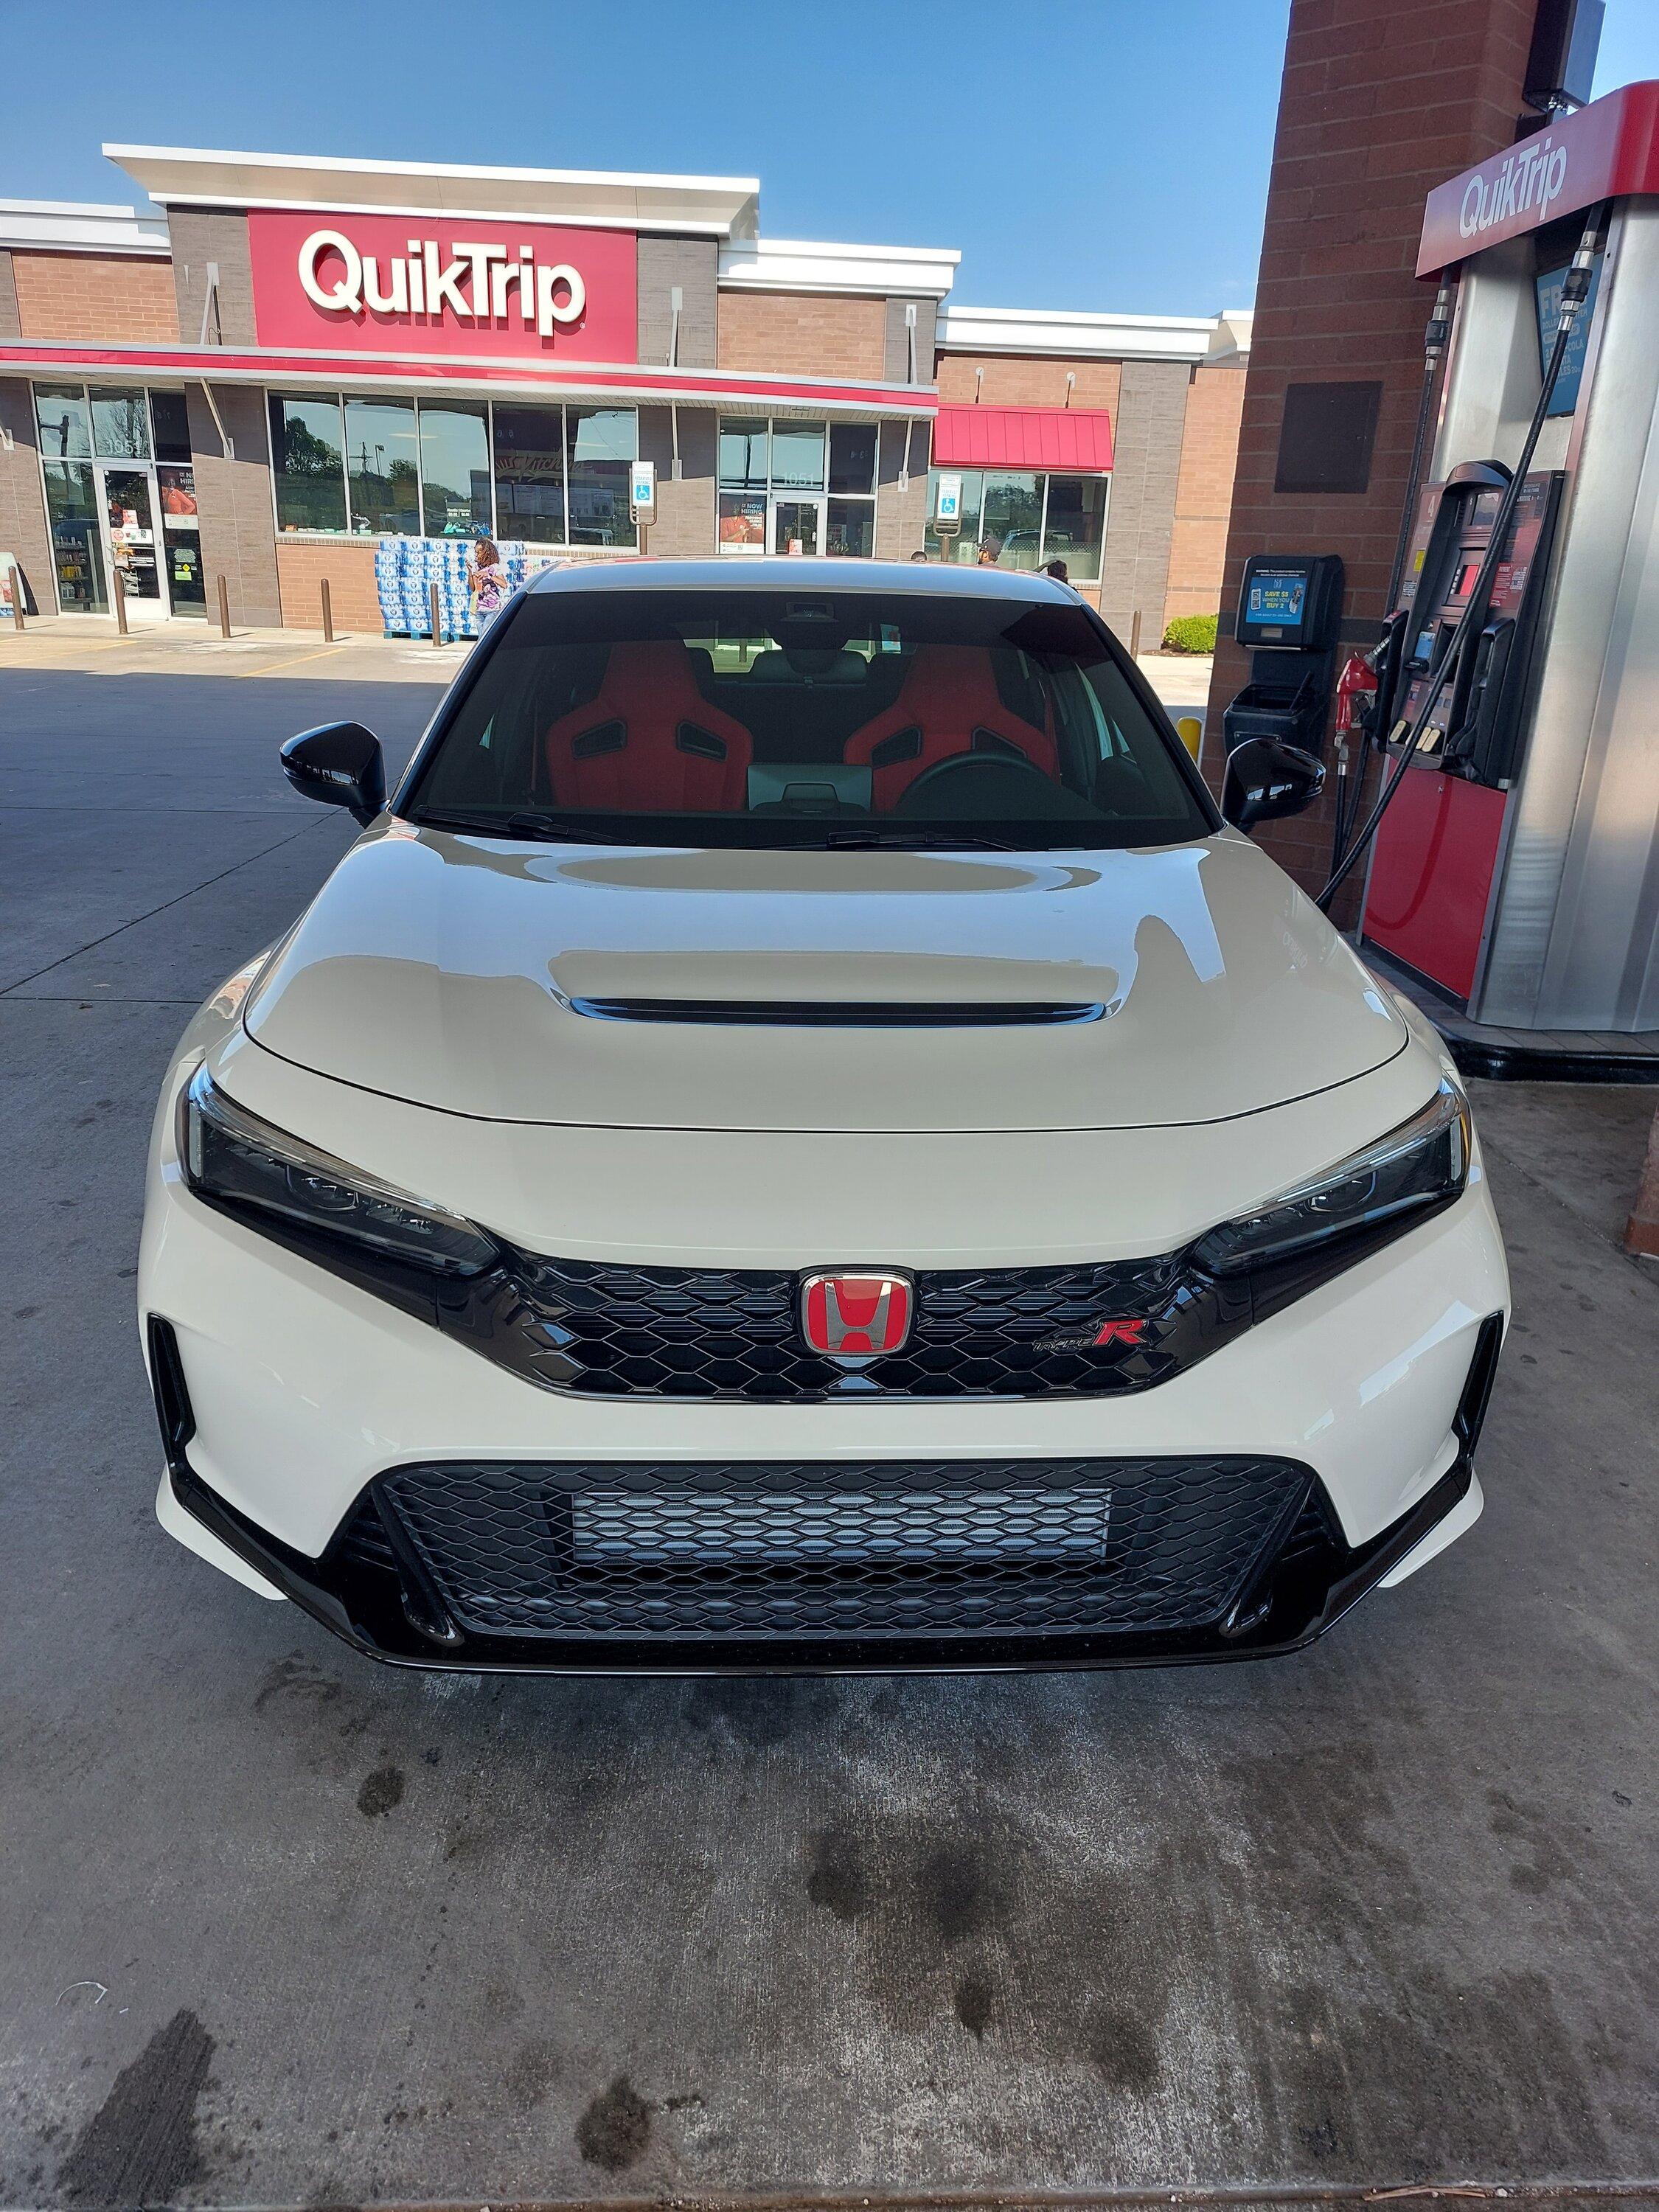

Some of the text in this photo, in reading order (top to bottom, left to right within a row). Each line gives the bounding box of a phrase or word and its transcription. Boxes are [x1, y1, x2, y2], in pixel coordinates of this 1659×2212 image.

[1459, 136, 1567, 239] QuikTrip
[298, 229, 587, 338] QuikTrip
[784, 472, 814, 487] 1051
[1427, 495, 1436, 517] 4
[1093, 1318, 1150, 1346] R
